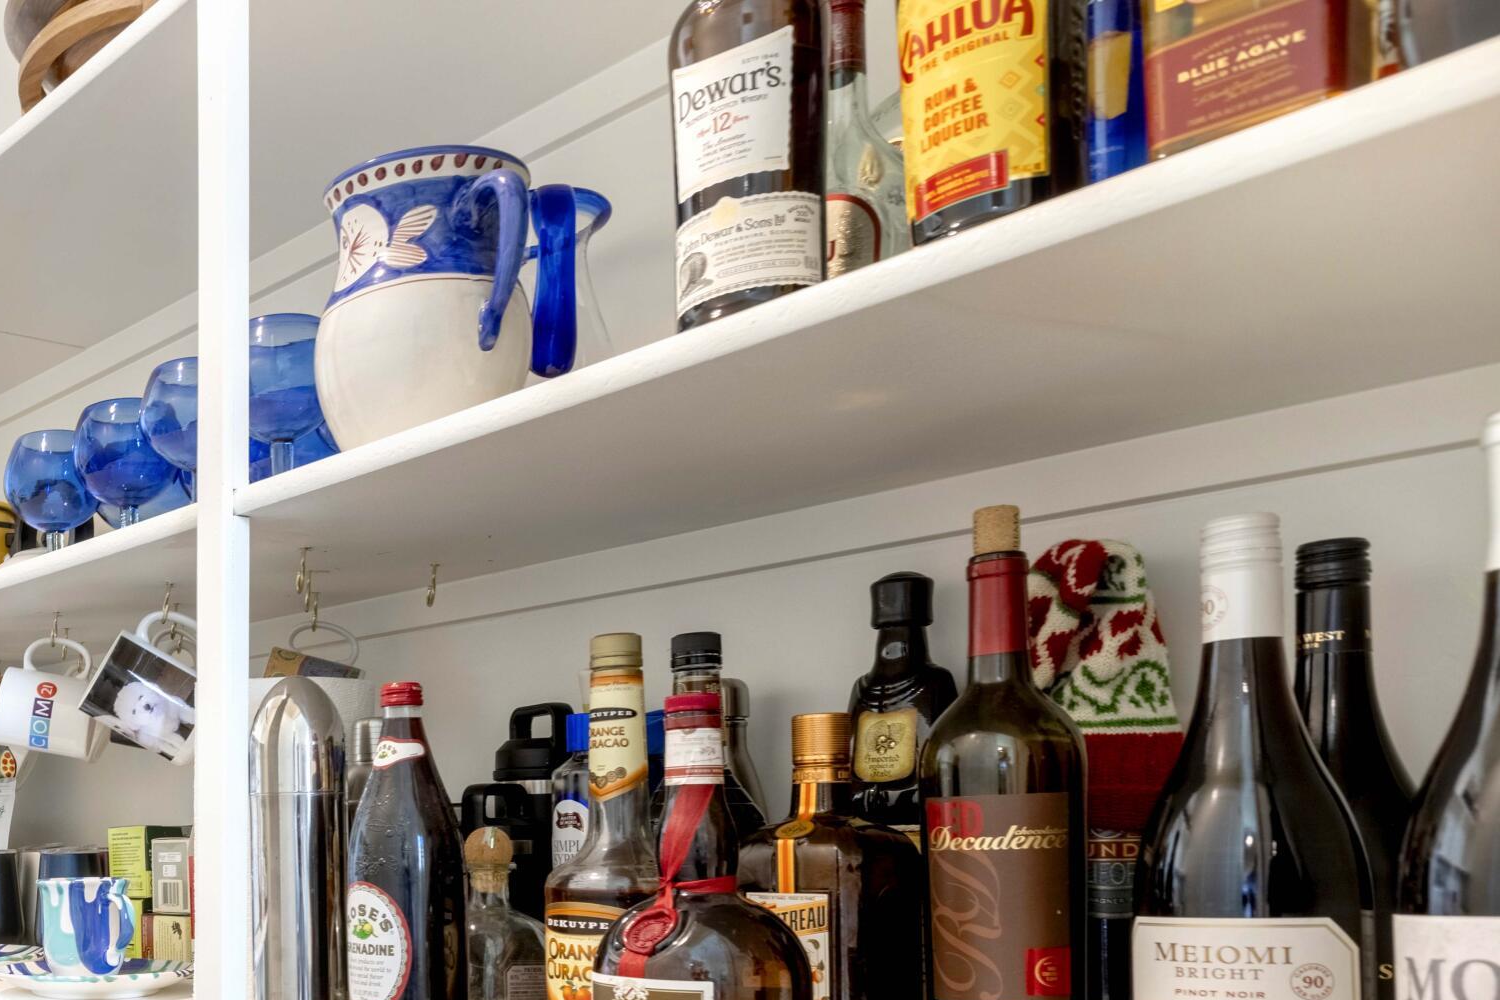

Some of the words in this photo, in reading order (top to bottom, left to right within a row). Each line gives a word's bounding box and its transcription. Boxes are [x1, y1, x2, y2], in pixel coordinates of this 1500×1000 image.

[943, 31, 1010, 62] ORIGINAL
[1177, 56, 1230, 83] BLUE
[1235, 29, 1307, 62] AGAVE
[678, 61, 782, 124] Dewar's
[924, 84, 957, 113] RUM
[964, 78, 977, 93] &
[712, 112, 732, 134] 12
[924, 94, 982, 132] COFFEE
[920, 112, 989, 153] LIQUEUR
[930, 824, 1069, 851] Decadence
[1155, 942, 1292, 965] MEIOMI
[1175, 967, 1264, 982] BRIGHT
[1302, 975, 1325, 990] 90
[1175, 988, 1218, 998] PINOT
[1226, 990, 1266, 999] NOIR
